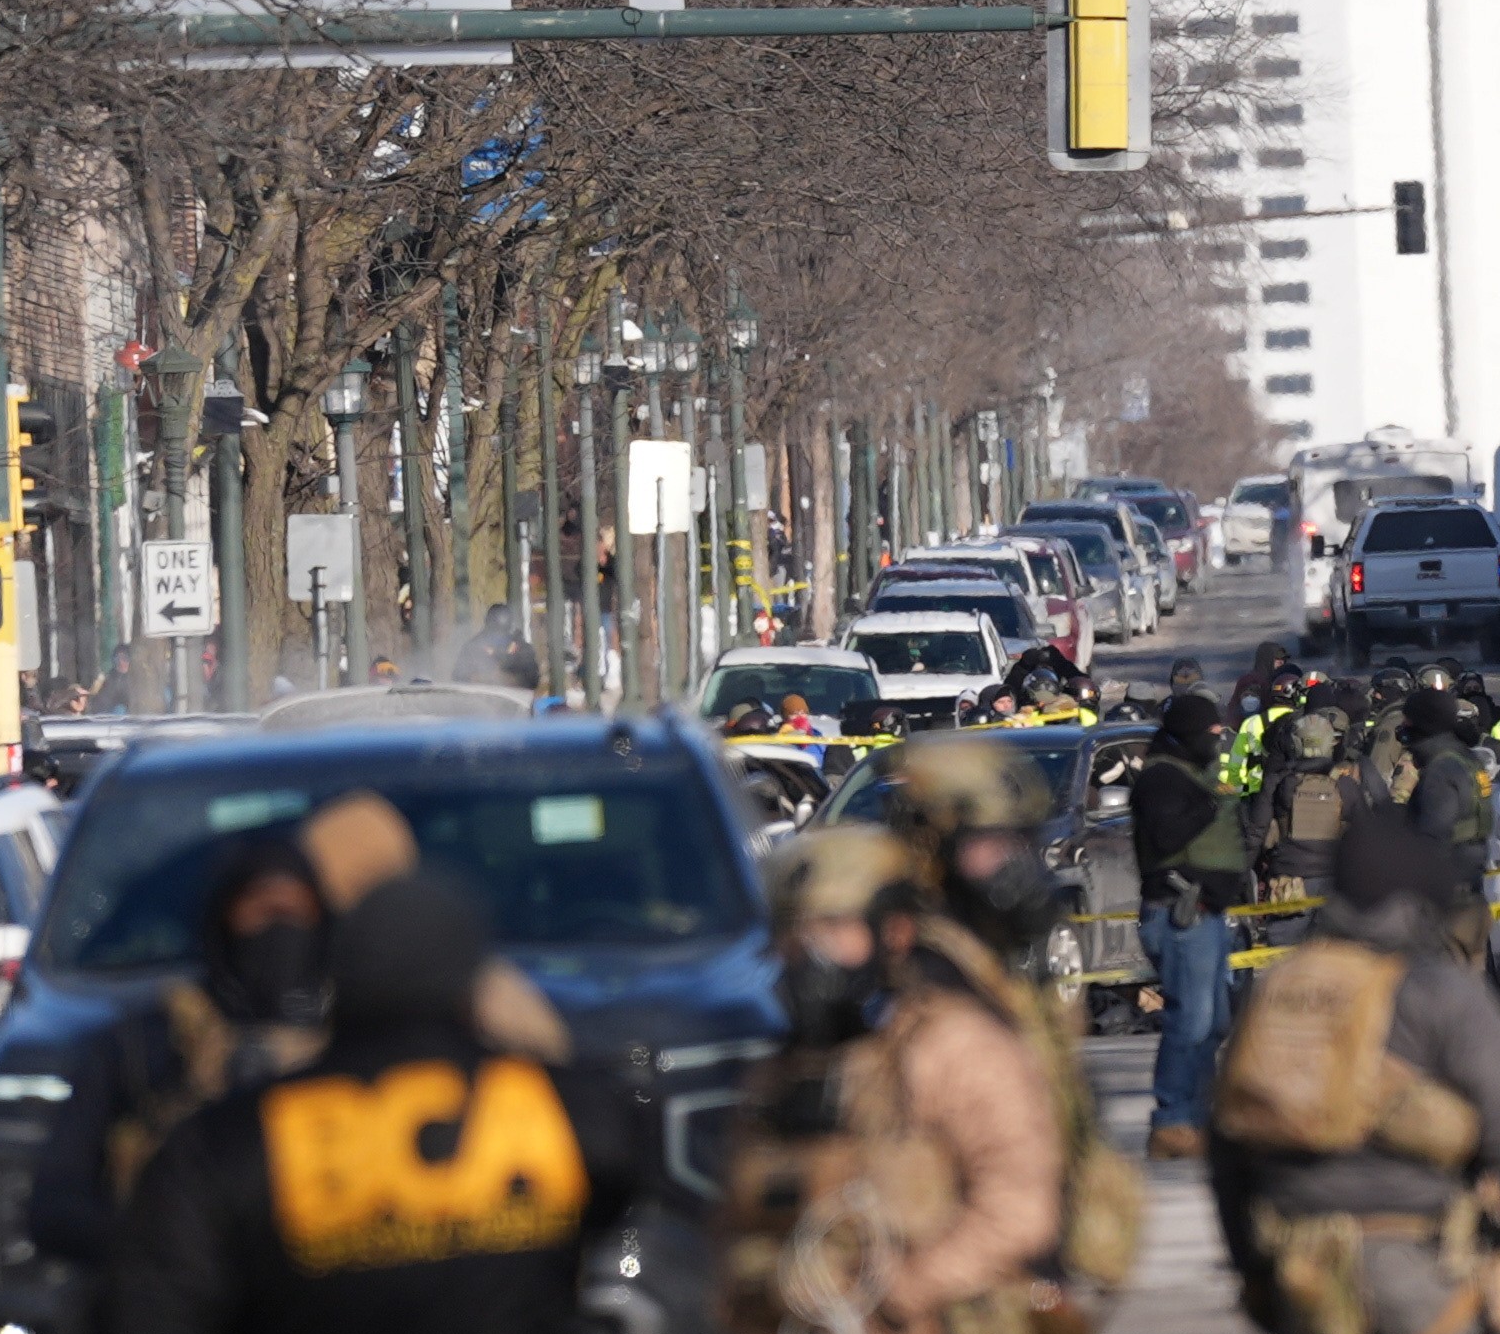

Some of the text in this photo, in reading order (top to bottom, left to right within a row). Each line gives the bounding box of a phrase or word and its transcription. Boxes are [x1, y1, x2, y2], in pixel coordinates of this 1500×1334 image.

[157, 549, 200, 569] ONE
[156, 573, 201, 595] WAY
[258, 1057, 593, 1239] BCA
